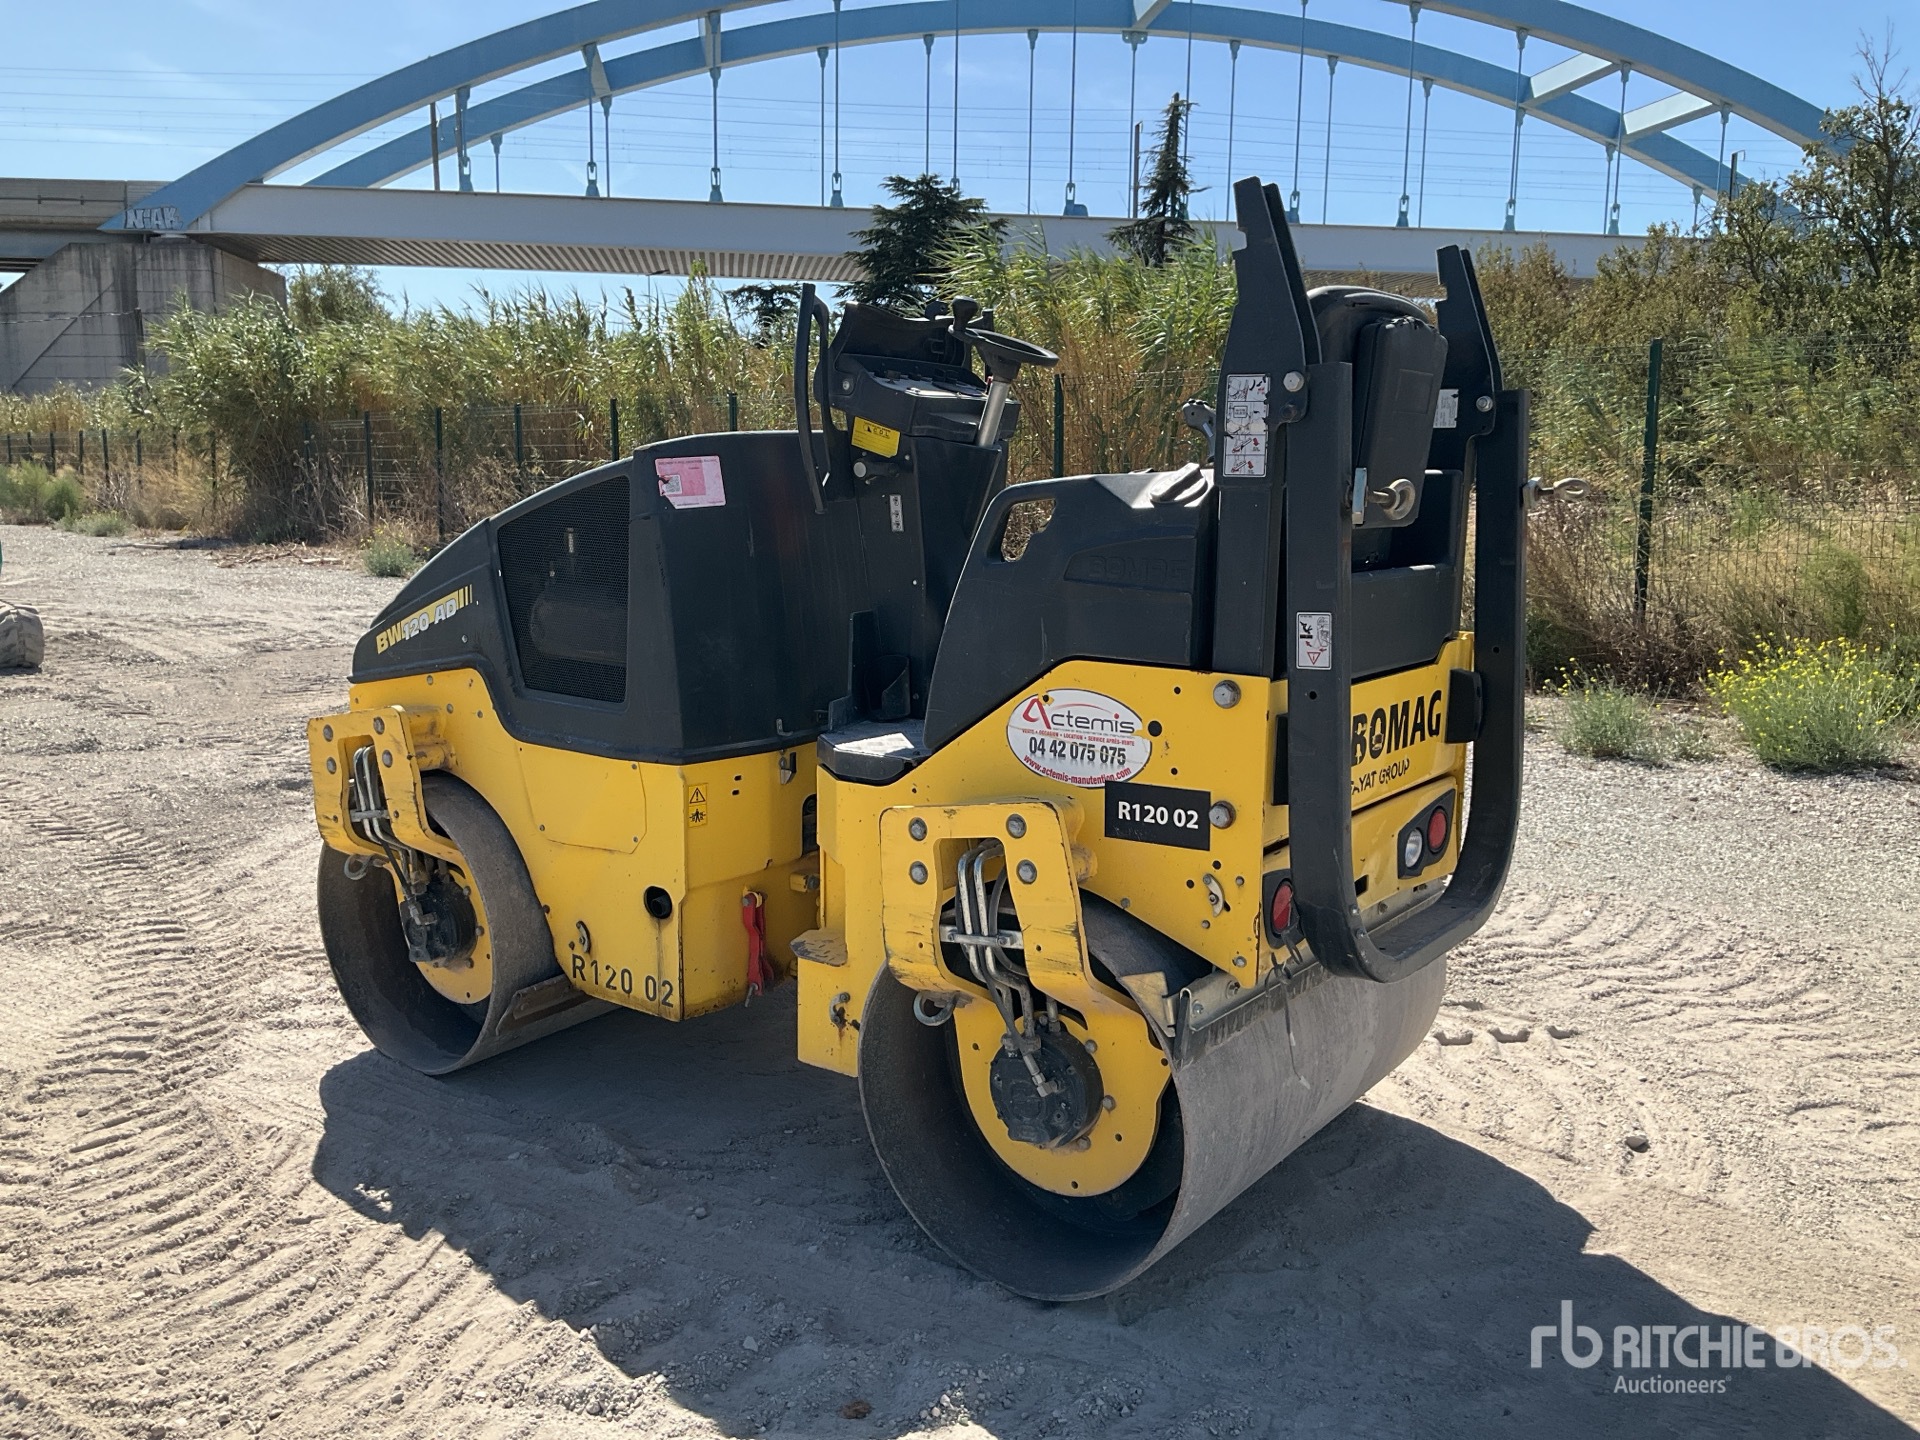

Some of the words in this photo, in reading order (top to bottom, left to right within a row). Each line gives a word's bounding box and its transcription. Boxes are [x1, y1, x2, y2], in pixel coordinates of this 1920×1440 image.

[433, 598, 458, 625] AD
[1022, 698, 1135, 734] Actemis
[1351, 690, 1442, 767] BOMAG
[1029, 736, 1046, 755] 04
[1049, 740, 1066, 758] 42
[1070, 741, 1096, 762] 075
[1100, 745, 1126, 766] 075
[1023, 755, 1132, 785] www.actemis-manutention.com
[1379, 758, 1410, 784] GROUP
[1118, 801, 1169, 825] R120
[1173, 808, 1199, 830] 02
[572, 953, 633, 994] R120
[645, 975, 674, 1008] 02
